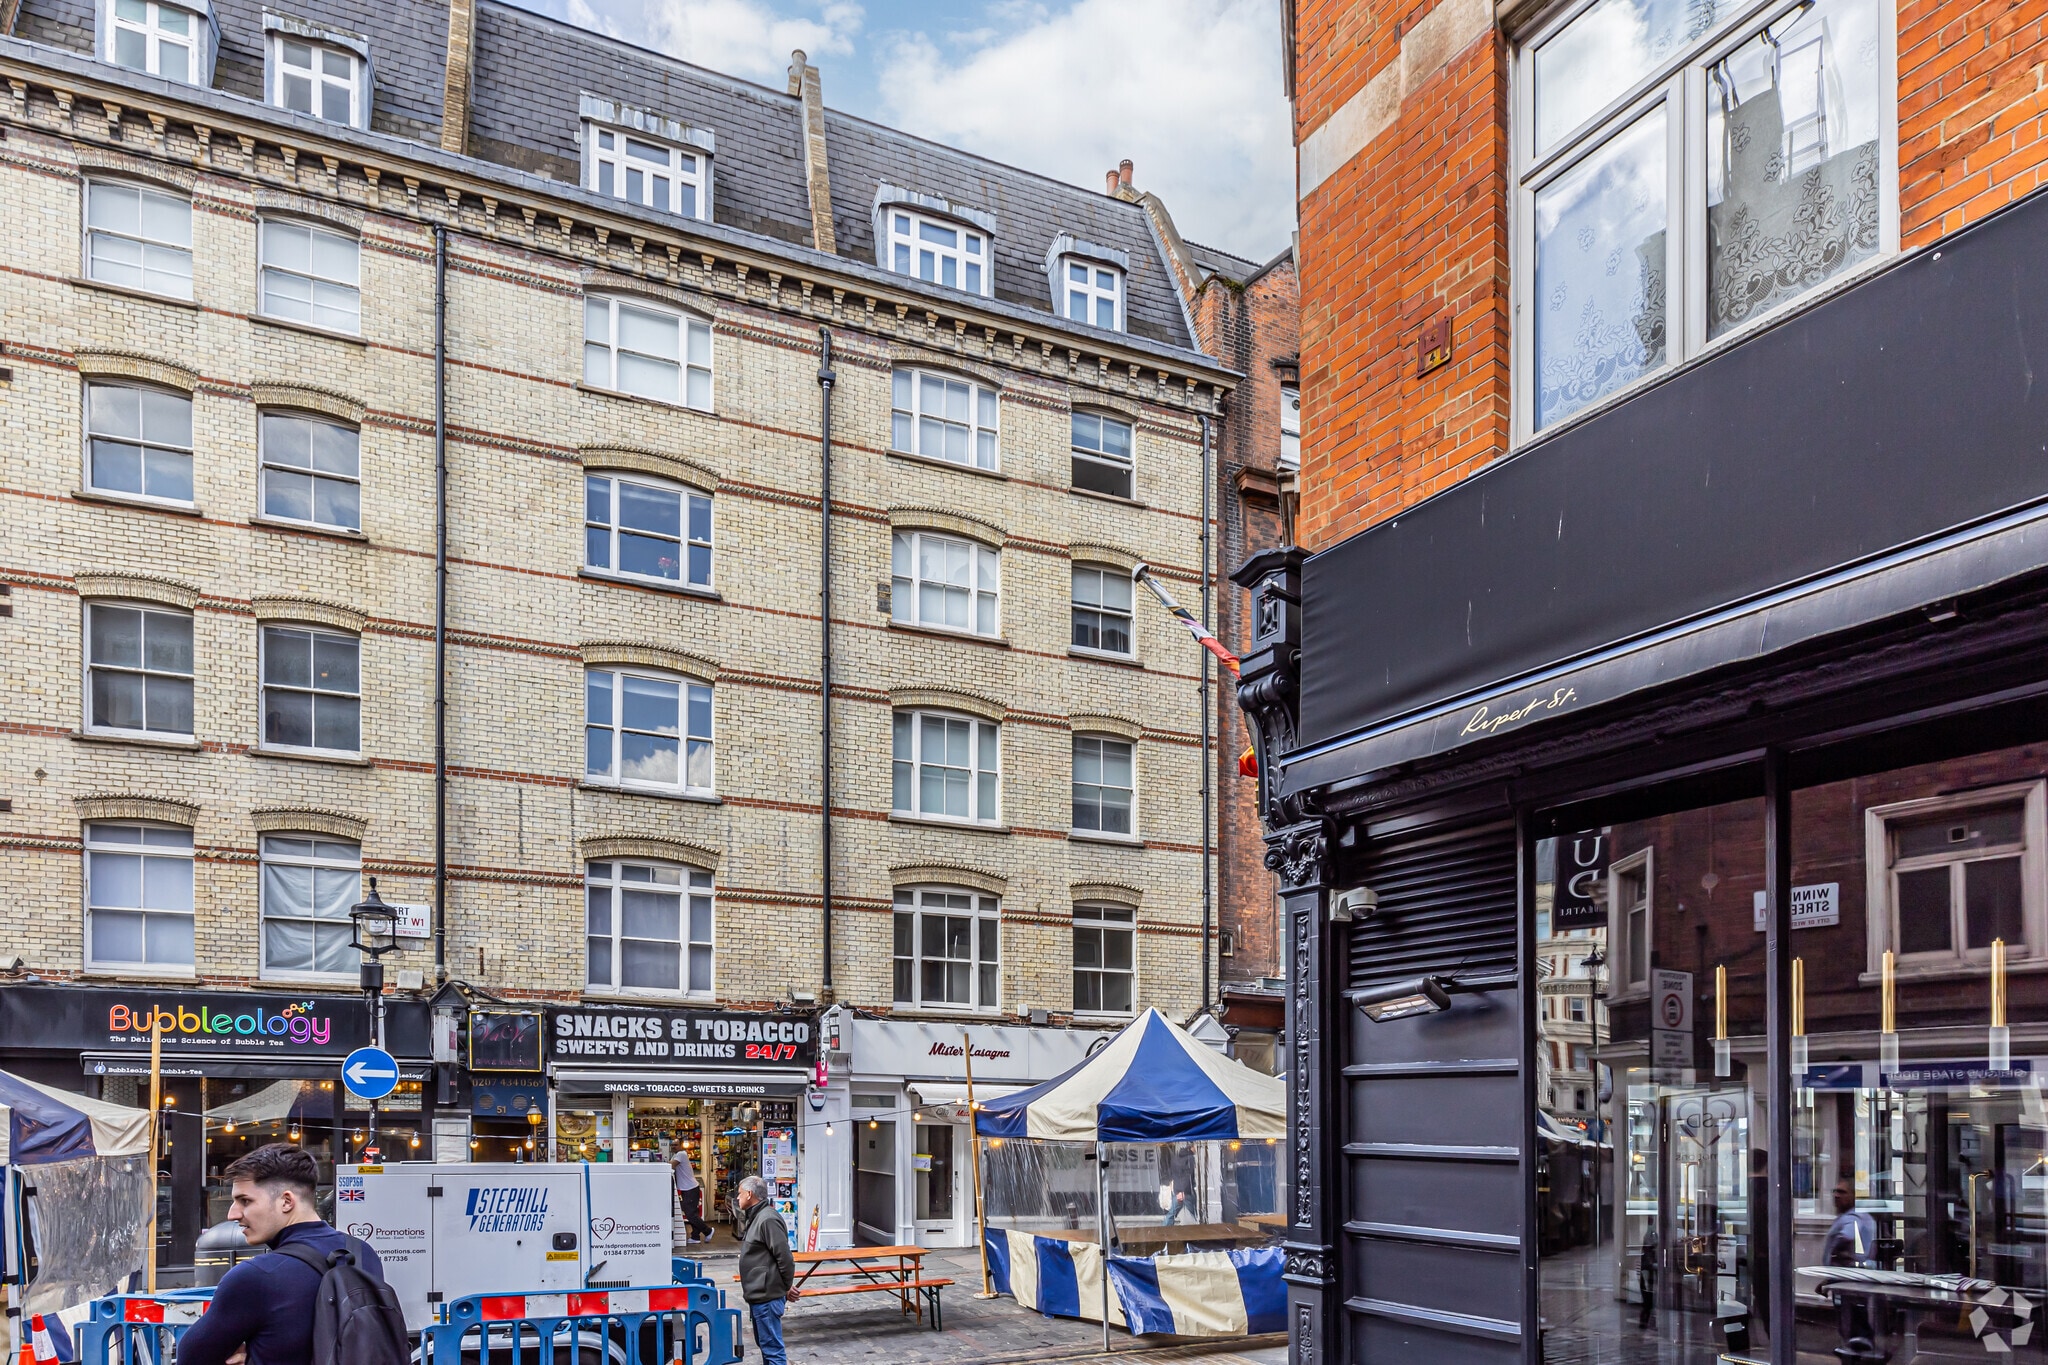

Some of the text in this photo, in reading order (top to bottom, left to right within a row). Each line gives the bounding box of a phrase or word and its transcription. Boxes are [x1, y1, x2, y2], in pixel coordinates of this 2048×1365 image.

[1460, 687, 1578, 737] Rupert St.
[411, 917, 424, 927] W1
[109, 1003, 331, 1045] Bubbleology
[556, 1014, 663, 1039] SNACKS
[671, 1018, 688, 1040] &
[695, 1019, 809, 1043] TOBACCO
[181, 1037, 216, 1045] Science
[556, 1039, 798, 1060] SWEETS AND DRINKS 24/7
[928, 1041, 1010, 1060] Mister Lasagna
[108, 1067, 152, 1075] Bubbleolog
[472, 1078, 545, 1087] 0207 434 0569
[604, 1084, 640, 1092] SNACKS
[646, 1084, 686, 1093] TOBACCO
[692, 1085, 728, 1093] SWEETS
[496, 1106, 506, 1114] 51
[478, 1187, 548, 1213] STEPHILL
[479, 1214, 545, 1233] GENERATORS
[616, 1223, 660, 1231] Promotions
[352, 1228, 425, 1236] LSD Promotions
